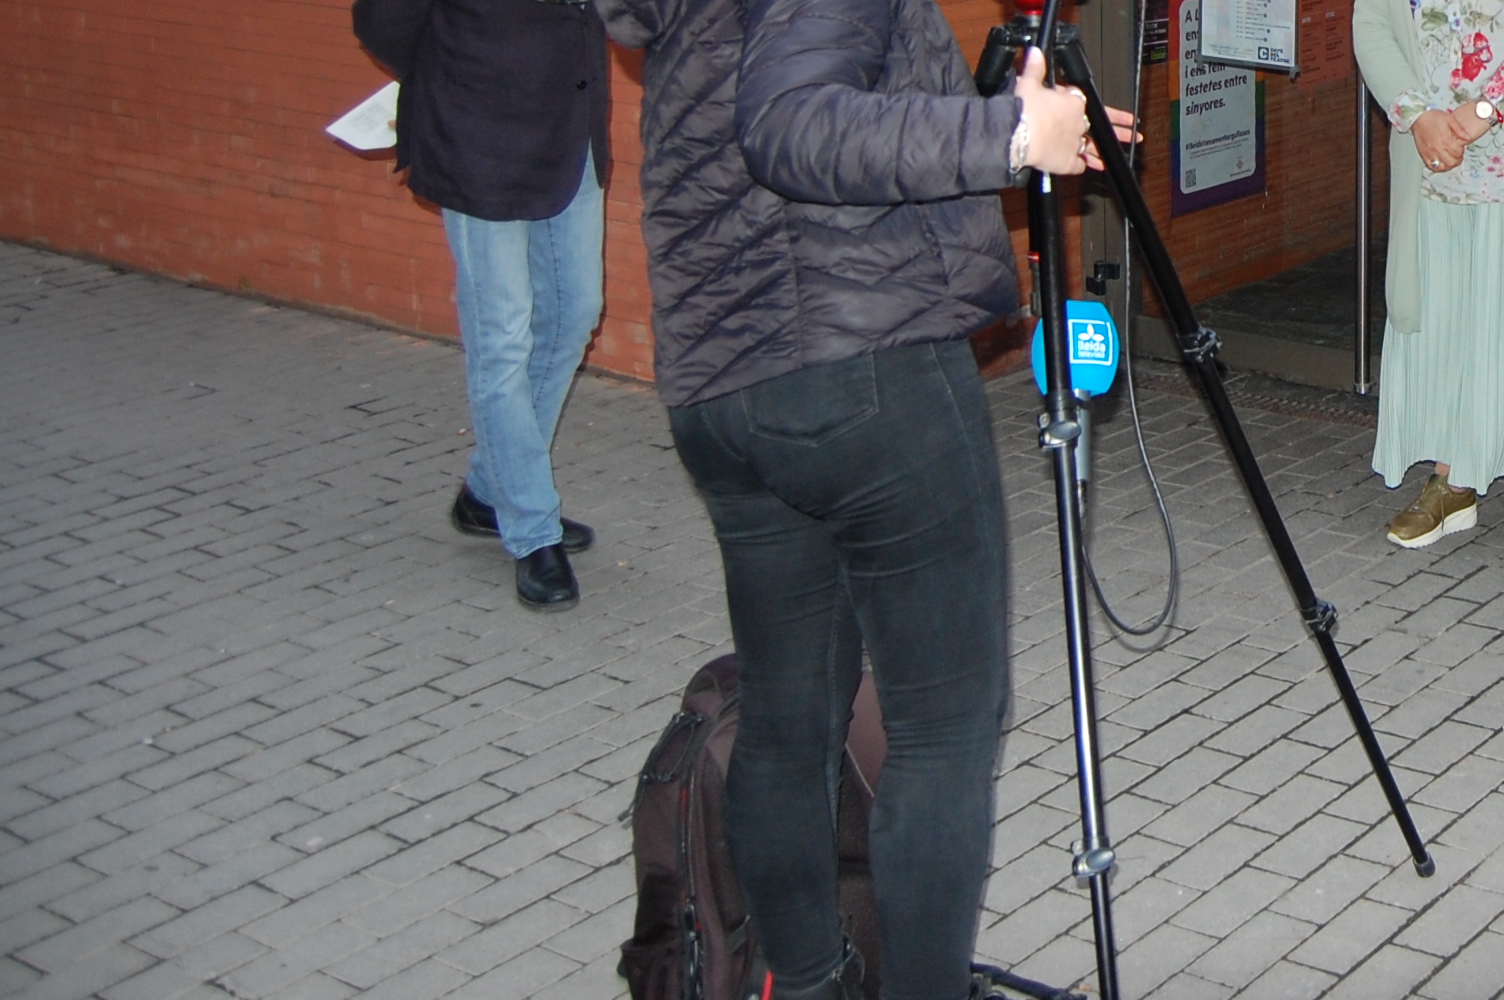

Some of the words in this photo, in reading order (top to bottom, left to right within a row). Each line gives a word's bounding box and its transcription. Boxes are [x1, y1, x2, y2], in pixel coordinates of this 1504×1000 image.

[1185, 80, 1222, 98] festetes
[1223, 74, 1248, 90] entre
[1185, 100, 1226, 116] sinyores.
